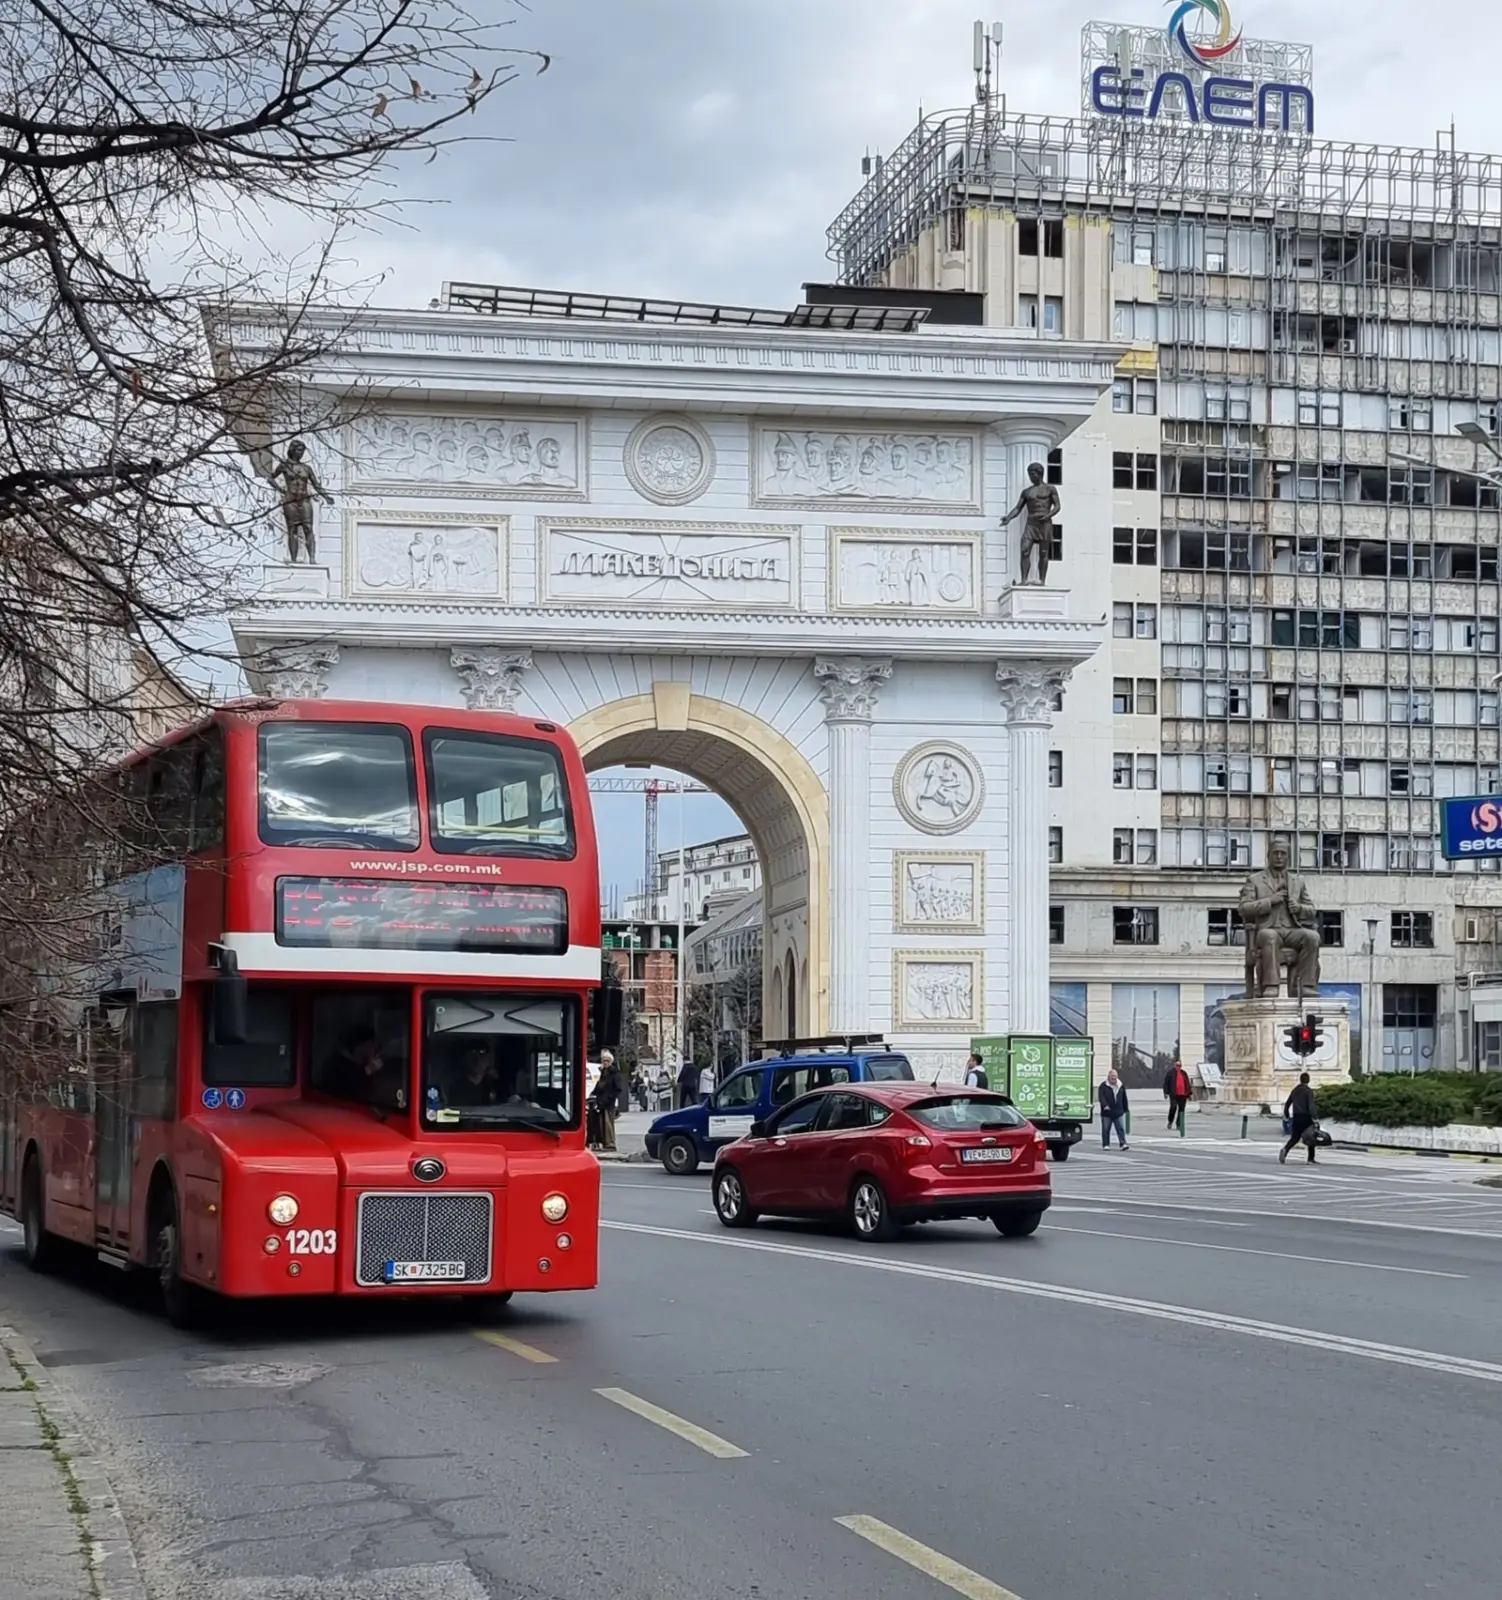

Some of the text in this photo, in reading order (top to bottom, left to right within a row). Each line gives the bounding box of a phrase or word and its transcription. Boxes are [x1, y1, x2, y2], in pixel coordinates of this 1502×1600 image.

[560, 552, 782, 580] МАКЕДОНИЈА
[350, 859, 502, 875] www.jsp.com.mk
[1016, 1063, 1045, 1071] POST
[285, 1229, 337, 1254] 1203
[394, 1264, 408, 1276] SK
